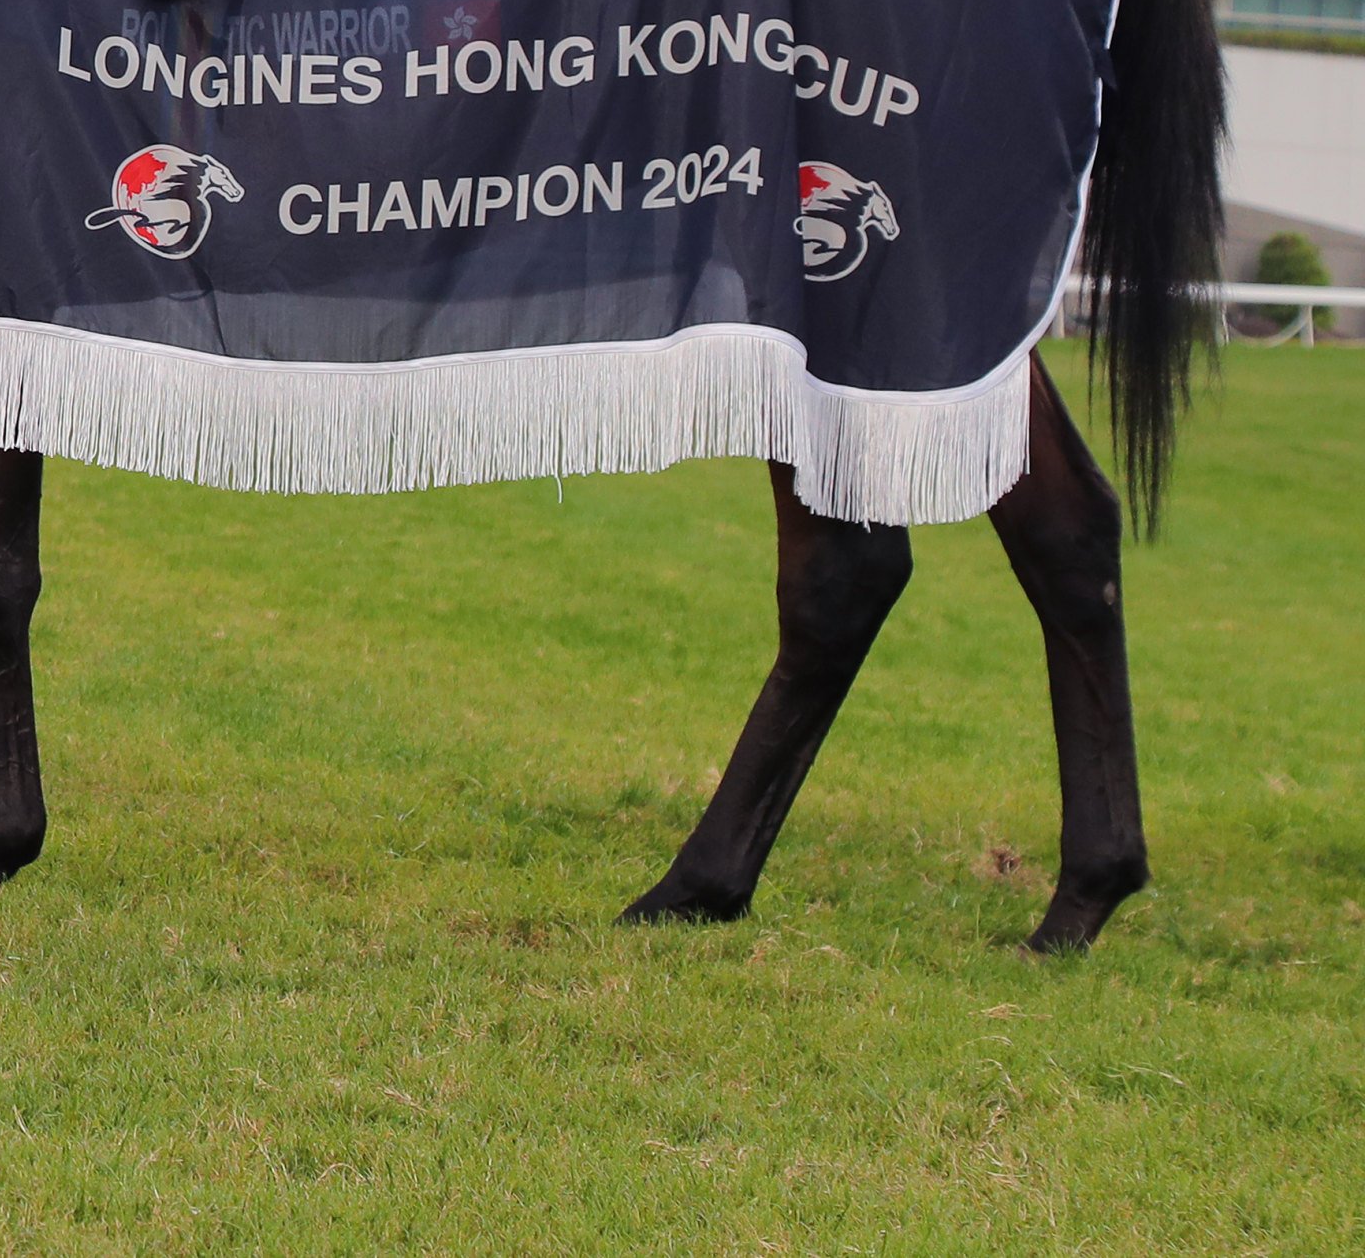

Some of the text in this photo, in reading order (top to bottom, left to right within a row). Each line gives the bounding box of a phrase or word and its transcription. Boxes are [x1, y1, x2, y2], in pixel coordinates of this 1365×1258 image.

[58, 13, 920, 127] LONGINES HONG KONG CUP
[279, 145, 764, 235] CHAMPION 2024
